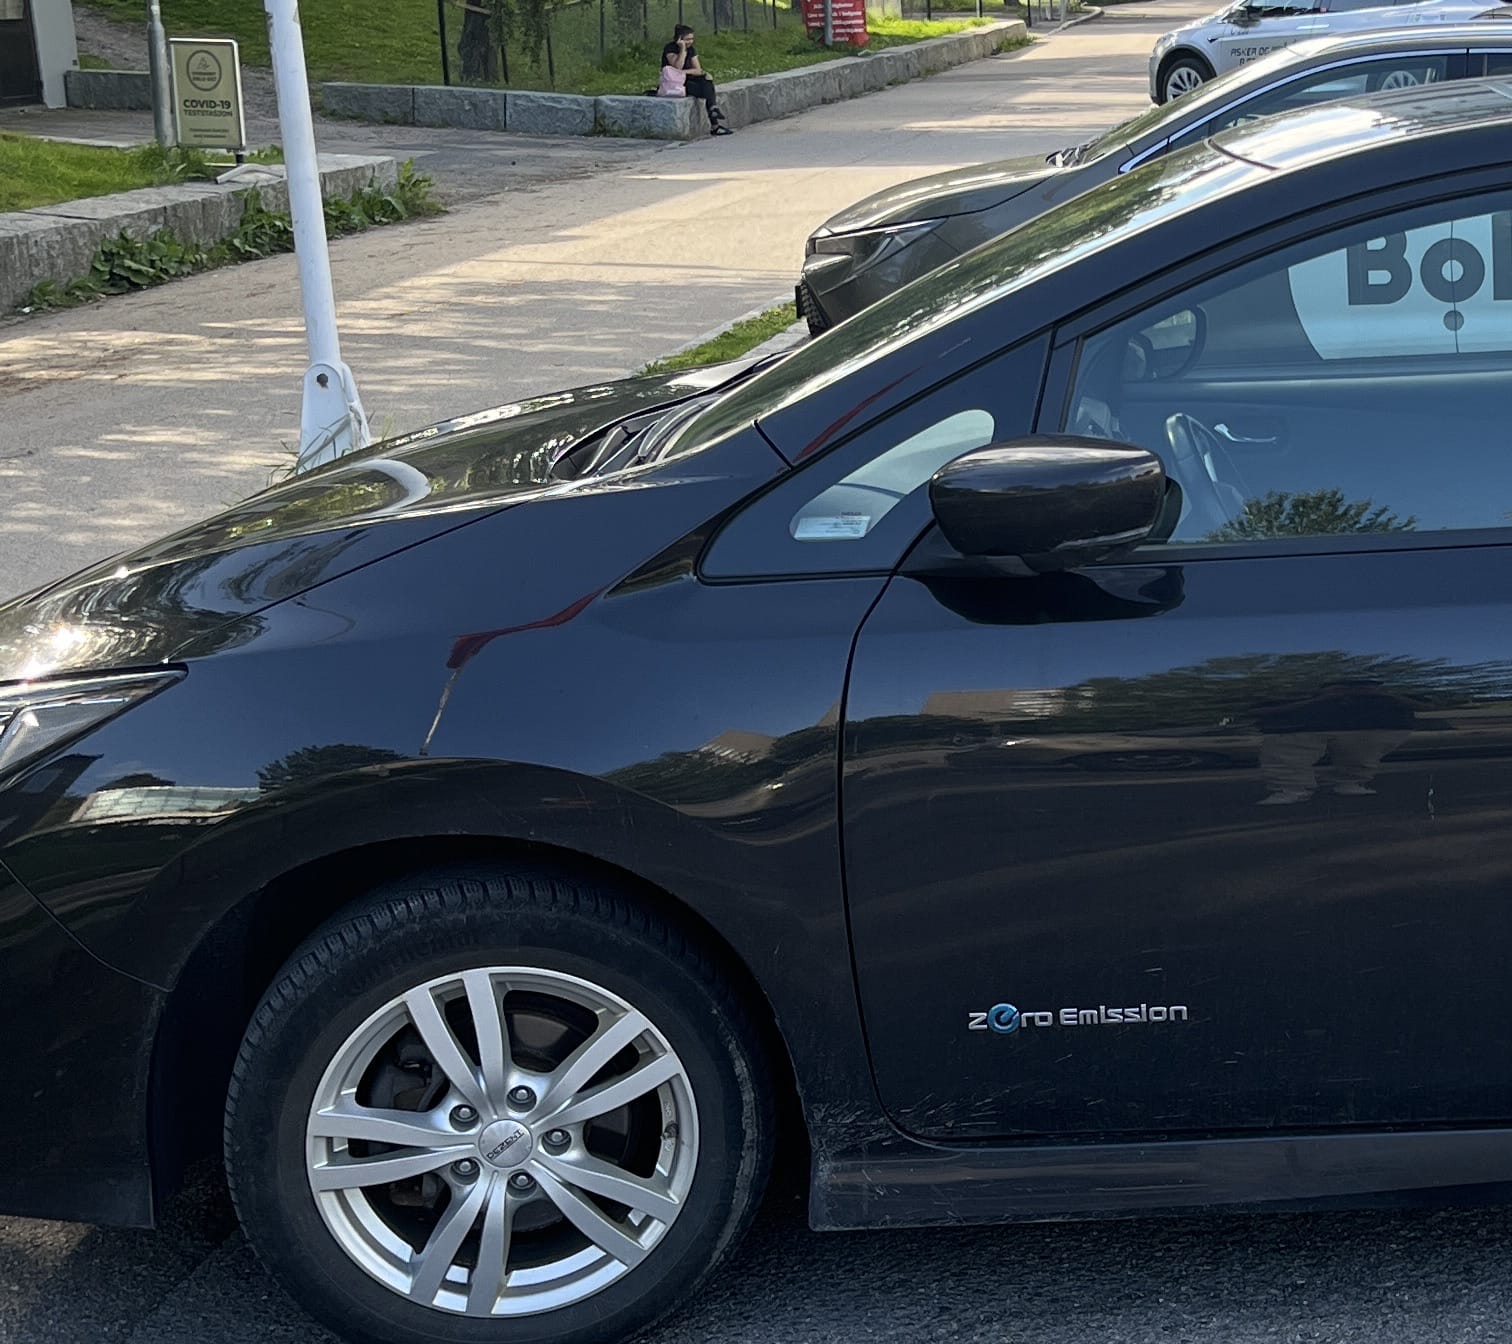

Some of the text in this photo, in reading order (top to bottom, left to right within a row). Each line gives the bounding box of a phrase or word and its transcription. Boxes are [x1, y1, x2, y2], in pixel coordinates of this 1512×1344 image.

[183, 99, 231, 109] COVID-19
[968, 1003, 1188, 1034] zero Emission
[486, 1128, 525, 1160] DEZENT
